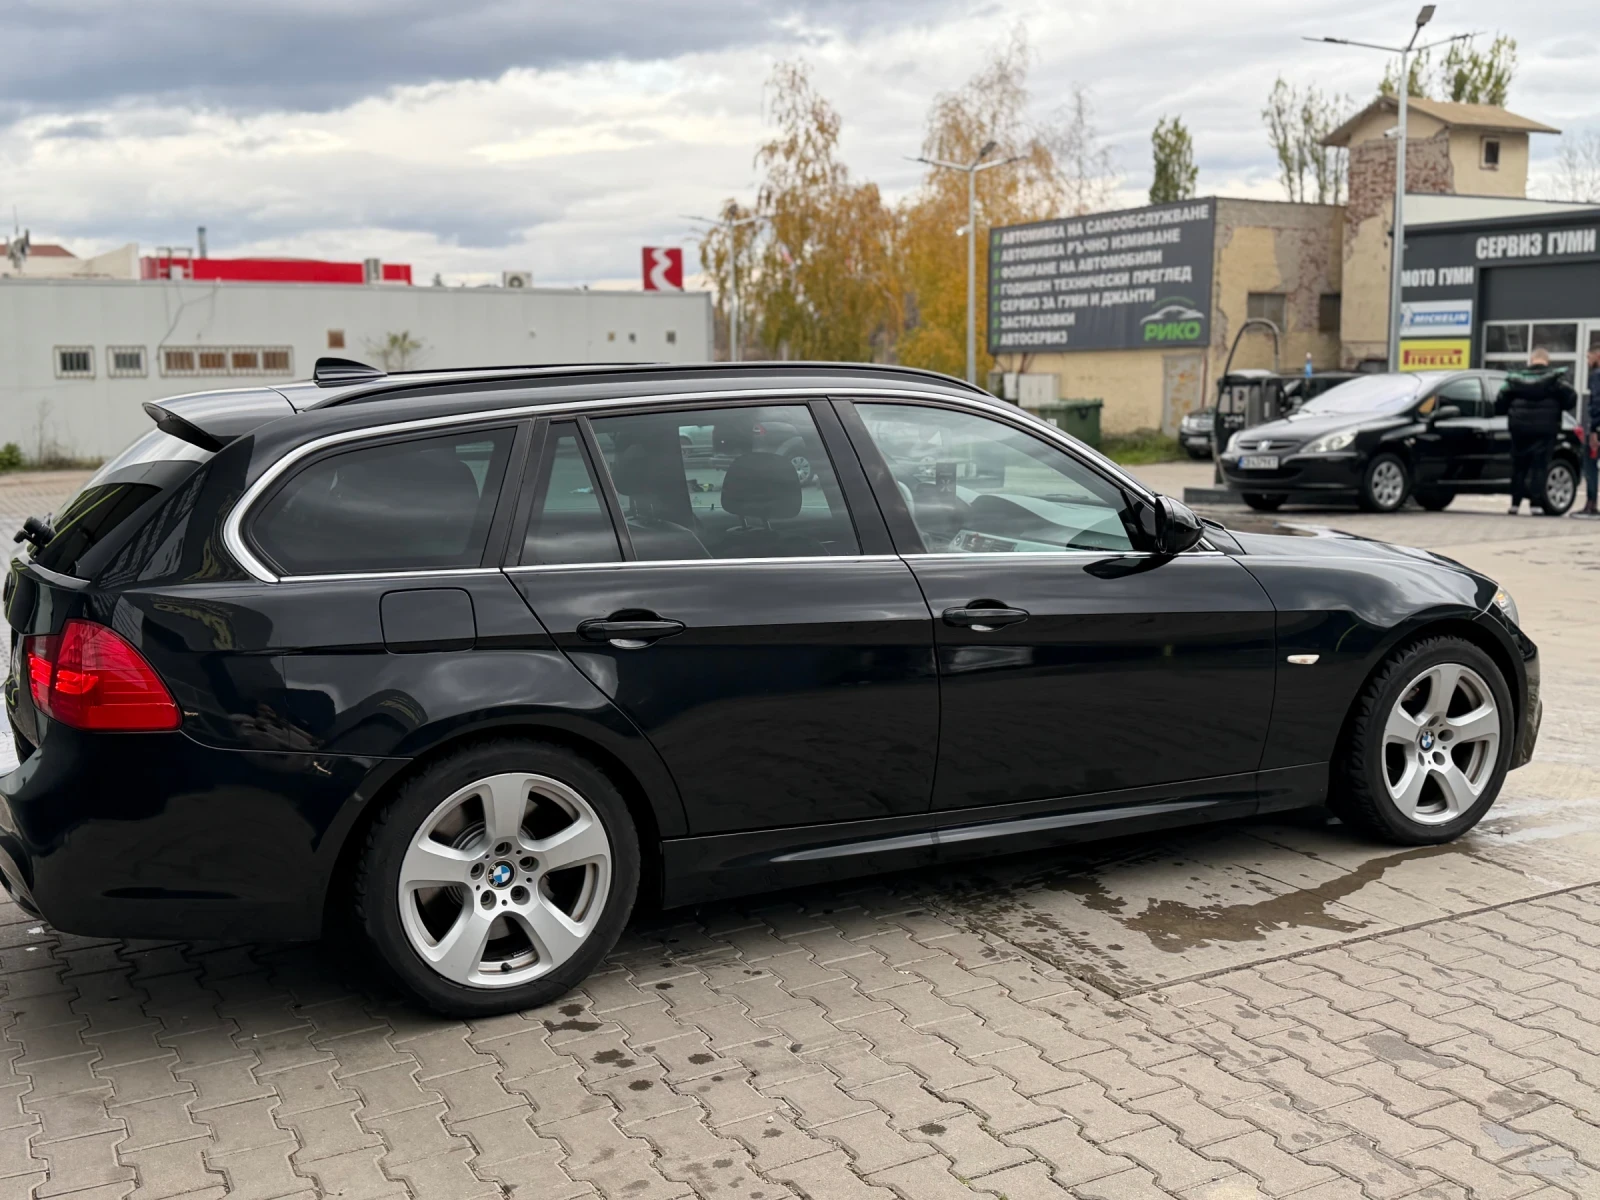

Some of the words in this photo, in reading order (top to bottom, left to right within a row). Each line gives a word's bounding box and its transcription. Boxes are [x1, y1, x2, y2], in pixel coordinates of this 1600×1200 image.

[1001, 225, 1065, 246] АВТОМИВКА
[1067, 222, 1084, 238] НА
[1085, 204, 1209, 235] САМООБСЛУЖВАНЕ
[1001, 243, 1065, 262] АВТОМИВКА
[1066, 237, 1109, 256] РЪЧНО
[1111, 227, 1181, 250] ИЗМИВАНЕ
[1476, 232, 1543, 260] СЕРВИЗ
[1547, 228, 1596, 255] ГУМИ
[1060, 258, 1077, 274] НА
[1078, 249, 1162, 272] АВТОМОБИЛИ
[1001, 279, 1052, 296] ГОДИШЕН
[1054, 271, 1130, 292] ТЕХНИЧЕСКИ
[1132, 266, 1193, 285] ПРЕГЛЕД
[1401, 268, 1436, 287] МОТО
[1438, 265, 1475, 286] ГУМИ
[1000, 296, 1040, 313] СЕРВИЗ
[1042, 295, 1056, 310] ЗА
[1058, 292, 1089, 309] ГУМИ
[1090, 291, 1100, 307] И
[1101, 287, 1155, 308] ДЖАНТИ
[1000, 312, 1076, 330] ЗАСТРАХОВКИ
[1144, 320, 1201, 341] РИКО
[1413, 313, 1468, 325] MICHELIN
[1001, 329, 1068, 346] АВТОСЕРВИЗ
[1403, 348, 1463, 366] PIRELLI
